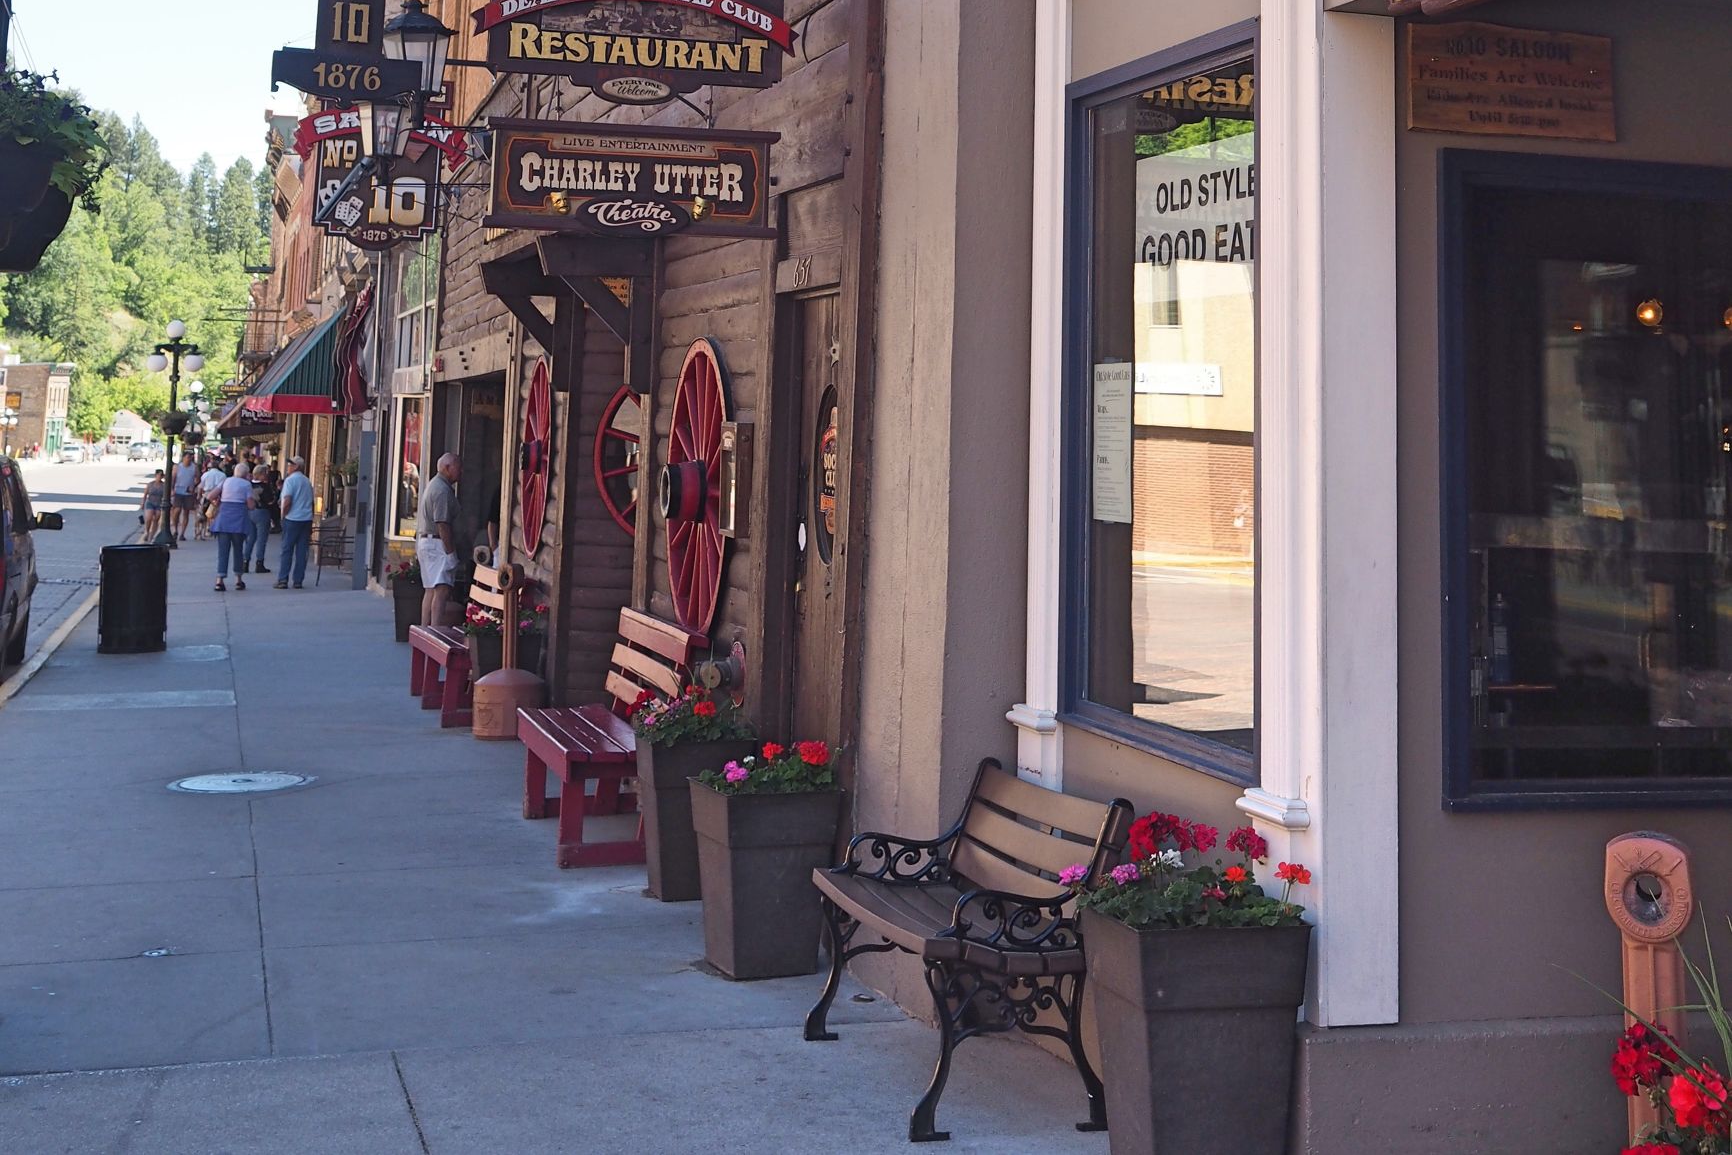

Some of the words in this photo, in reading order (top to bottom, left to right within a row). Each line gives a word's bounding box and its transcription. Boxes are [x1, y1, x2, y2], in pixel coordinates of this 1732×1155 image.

[332, 2, 371, 44] 10
[719, 0, 773, 33] CLUB
[508, 21, 768, 74] RESTAURANT
[312, 62, 382, 92] 1876
[617, 84, 660, 97] Welcome
[1418, 64, 1488, 82] Families
[1496, 70, 1526, 85] Are
[562, 137, 595, 148] LIVE
[599, 138, 706, 154] ENTERTAINMENT
[519, 151, 641, 193] CHARLEY
[653, 163, 743, 202] UTTER
[368, 175, 427, 227] 10
[1156, 178, 1192, 215] OLD
[588, 199, 677, 231] Theatre
[1142, 228, 1206, 269] GOOD
